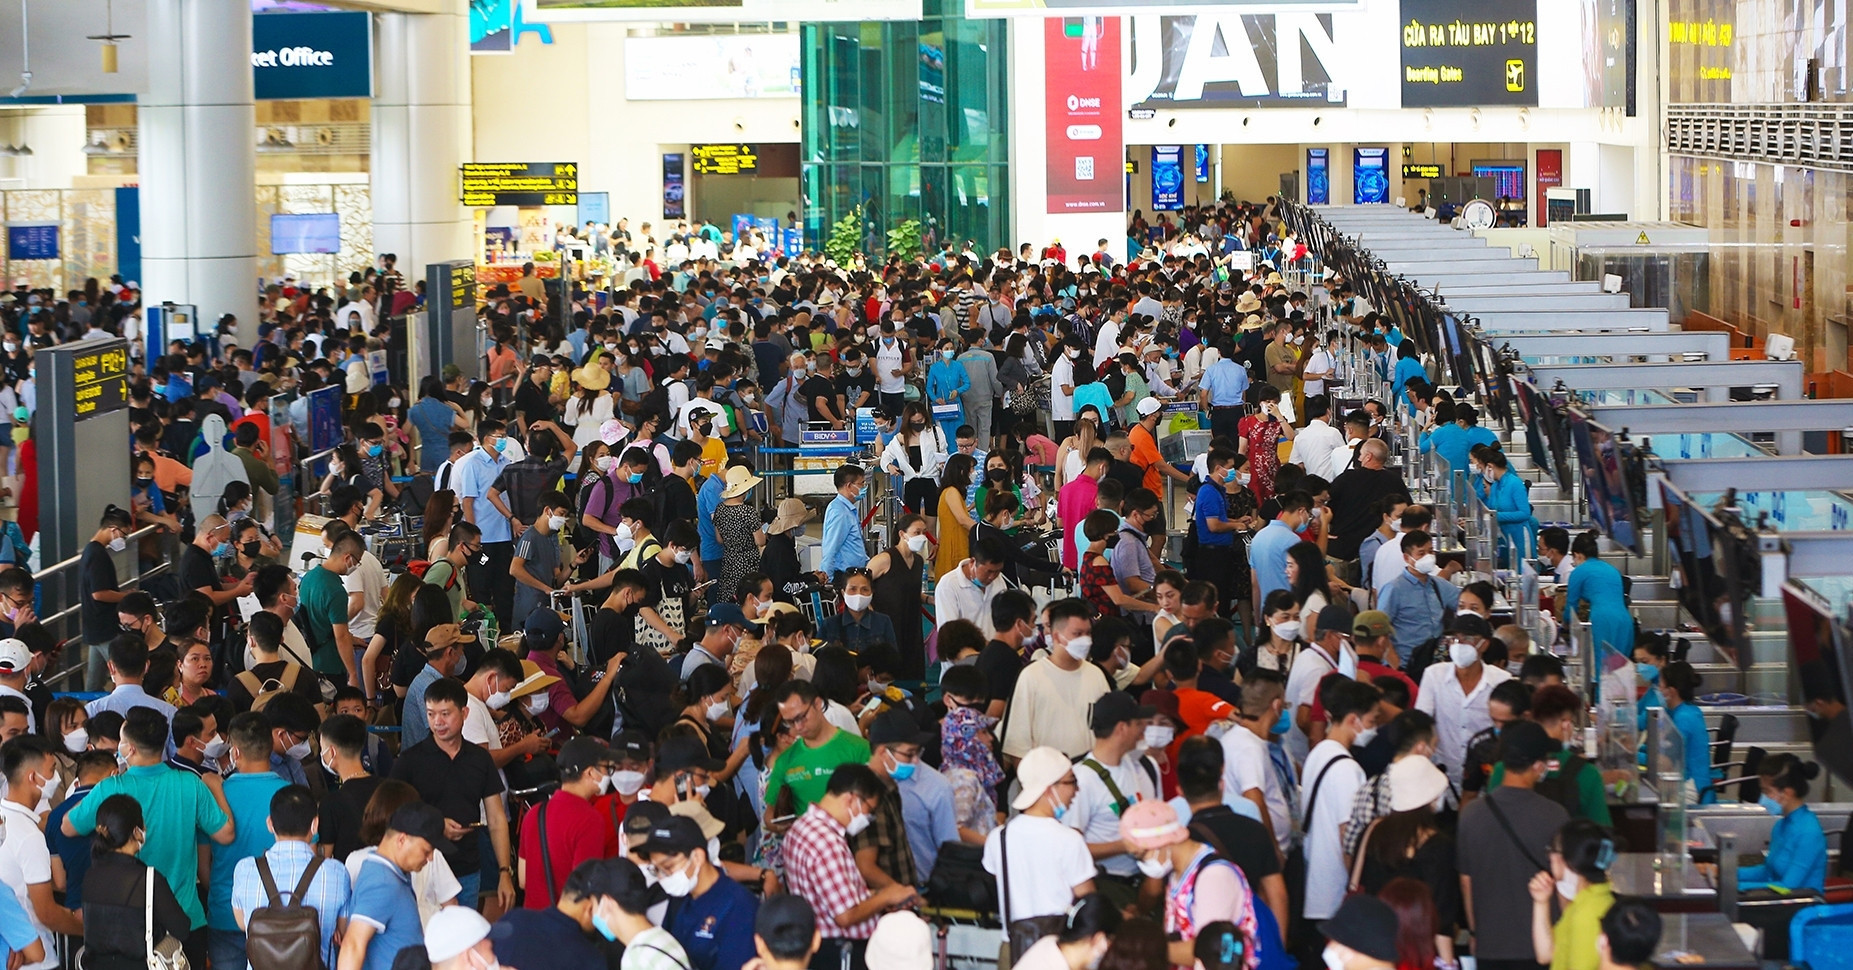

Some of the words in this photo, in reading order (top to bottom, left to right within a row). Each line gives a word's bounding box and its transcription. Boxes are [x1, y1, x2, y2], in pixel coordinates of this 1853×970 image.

[1429, 24, 1446, 46] RA
[1448, 19, 1470, 46] TÀU
[1473, 22, 1496, 46] BAY
[1520, 21, 1534, 44] 12
[279, 46, 334, 67] Office
[1406, 64, 1439, 84] Boarding
[1440, 64, 1463, 82] Gates
[1079, 97, 1100, 108] DNSE
